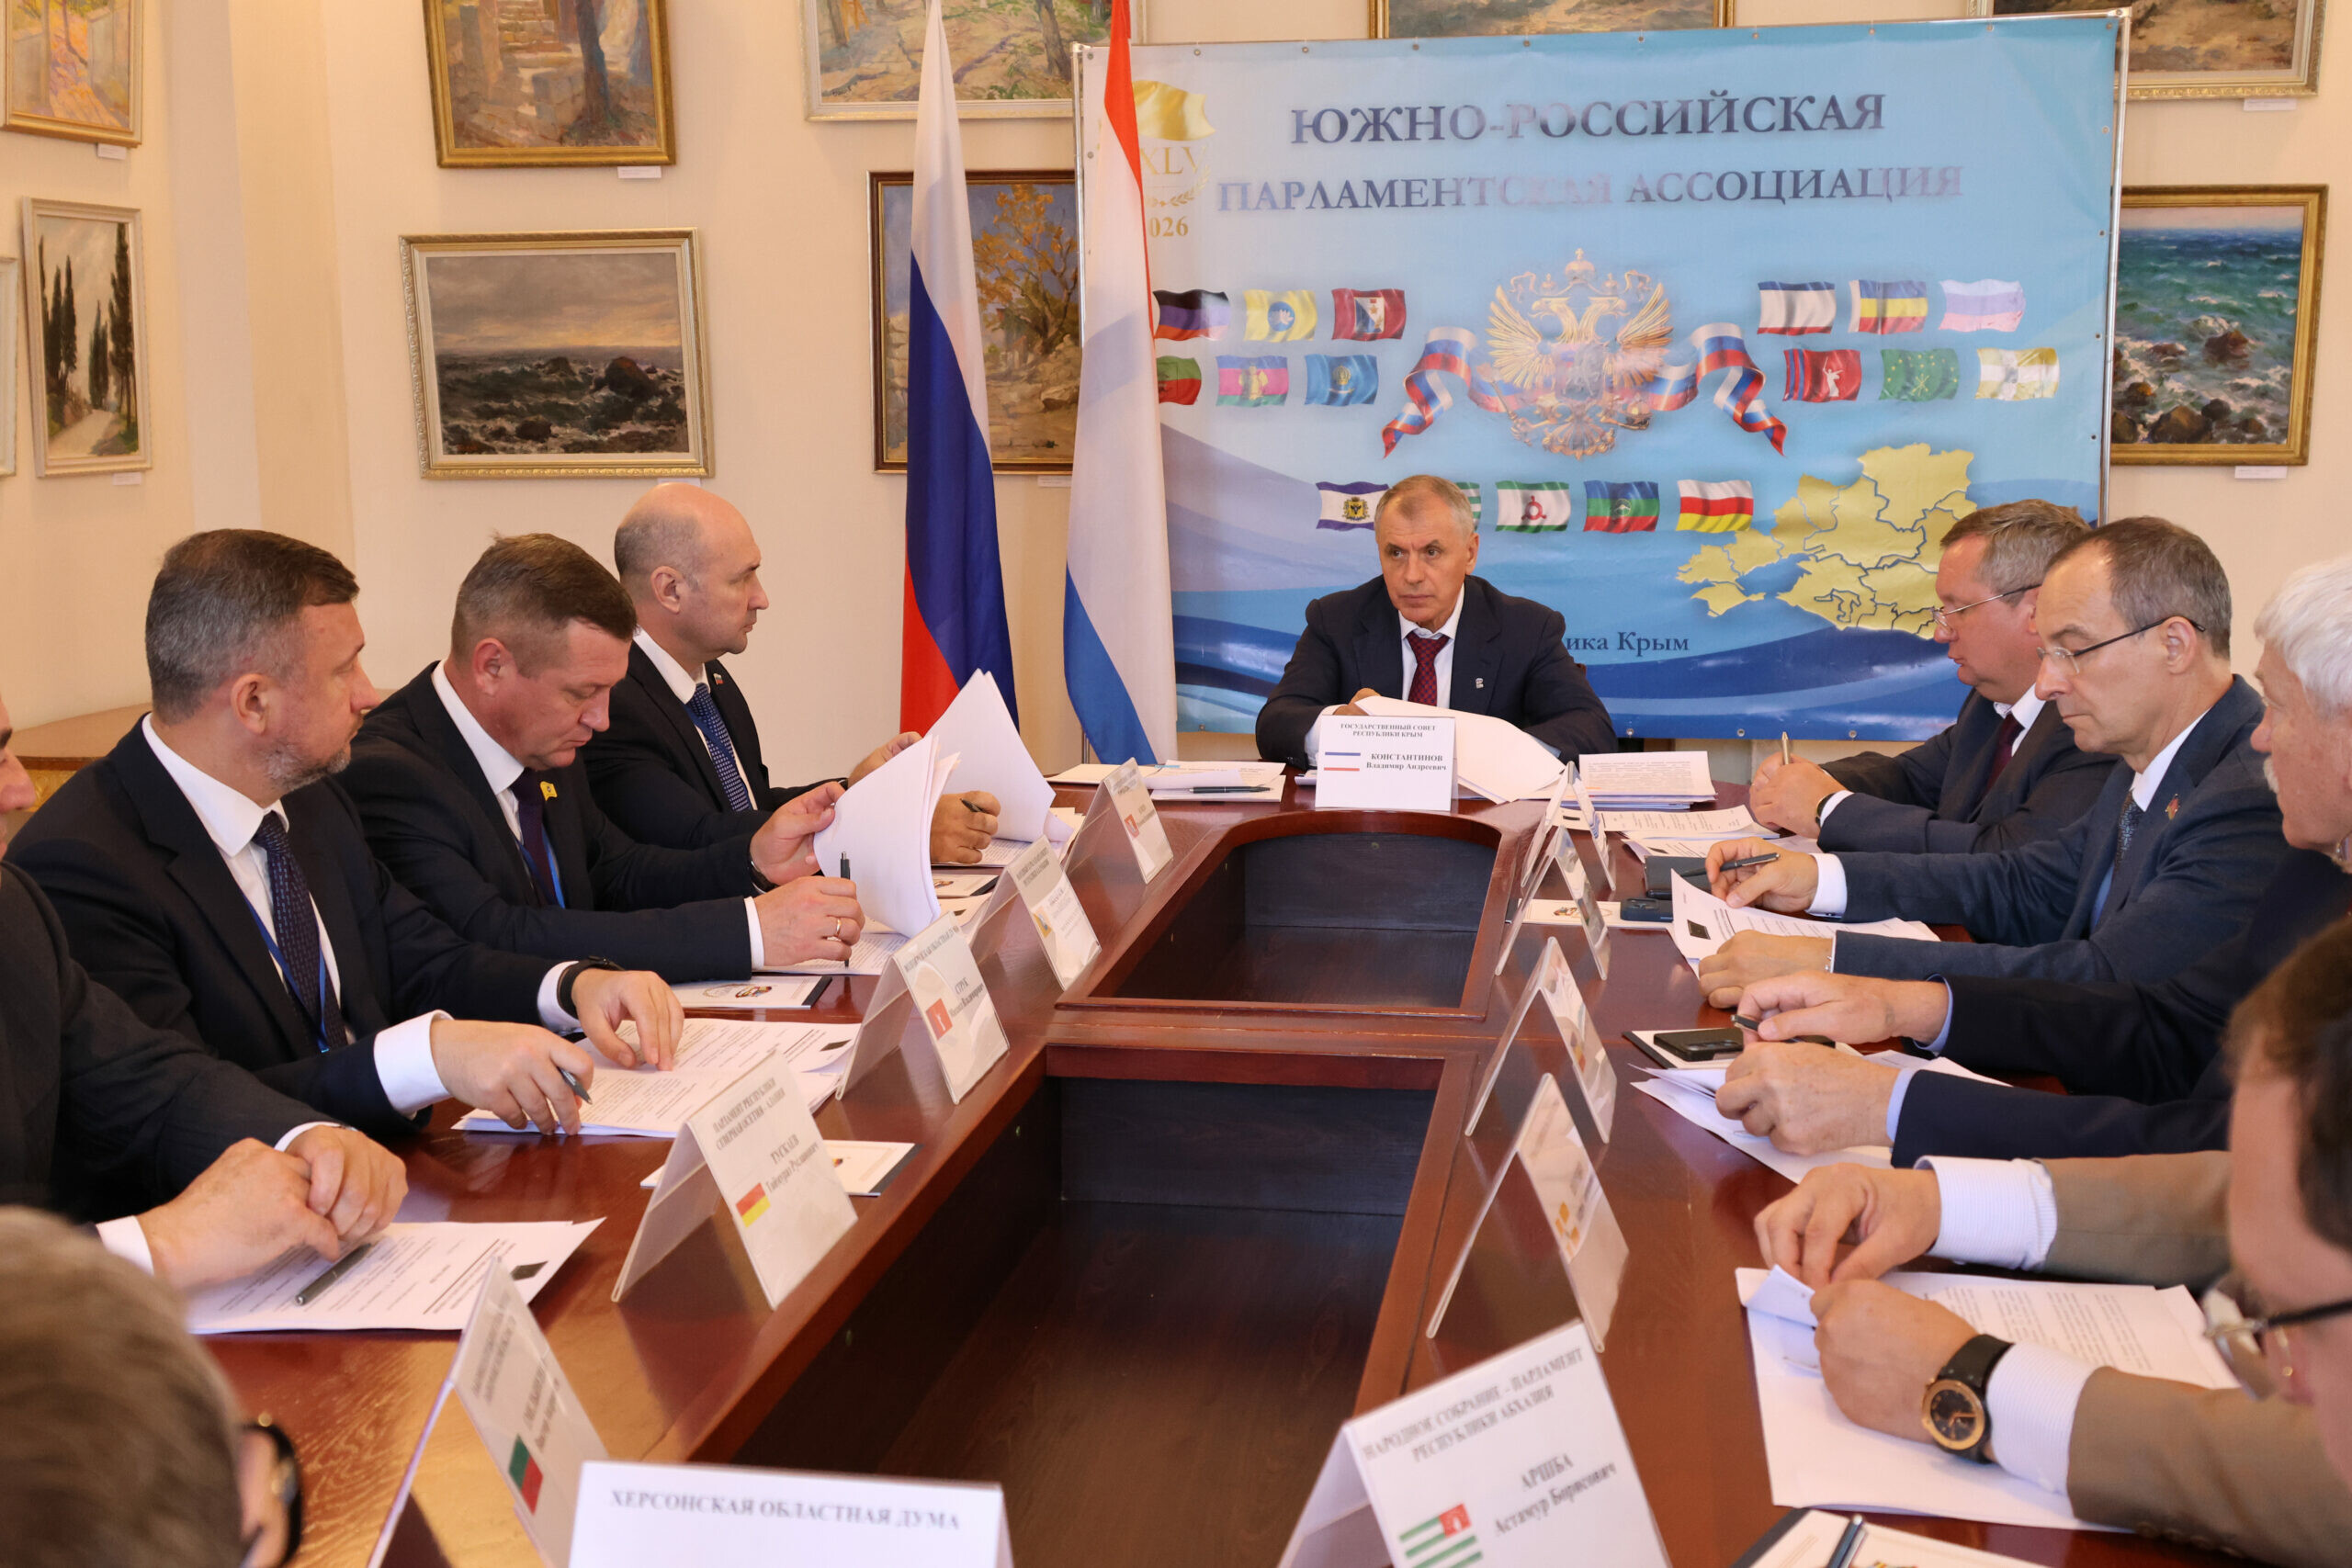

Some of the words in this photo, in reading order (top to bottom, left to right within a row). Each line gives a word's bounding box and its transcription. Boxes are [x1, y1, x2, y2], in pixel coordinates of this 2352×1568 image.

[1291, 89, 1885, 144] ЮЖНО-РОССИЙСКАЯ
[1217, 171, 1612, 212] ПАРЛАМЕНТСКАЯ
[1624, 166, 1963, 205] АССОЦИАЦИЯ
[1148, 217, 1189, 238] 026
[1617, 631, 1690, 657] Крым
[1340, 722, 1411, 731] ГОСУДАРСТВЕННЫЙ
[1366, 761, 1405, 771] Владимир
[1407, 762, 1446, 772] Андреевич
[1371, 753, 1443, 762] КОНСТАНТИНОВ
[1363, 1419, 1433, 1458] НАРОДНОЕ
[1436, 1389, 1500, 1424] СОБРАНИЕ
[1510, 1350, 1583, 1389] ПАРЛАМЕНТ
[1519, 1454, 1572, 1488] АРШБА
[611, 1489, 755, 1518] ХЕРСОНСКАЯ
[759, 1499, 891, 1525] ОБЛАСТНАЯ
[894, 1509, 960, 1531] ДУМА
[1494, 1497, 1549, 1536] Астамур
[1550, 1462, 1617, 1505] Борисович
